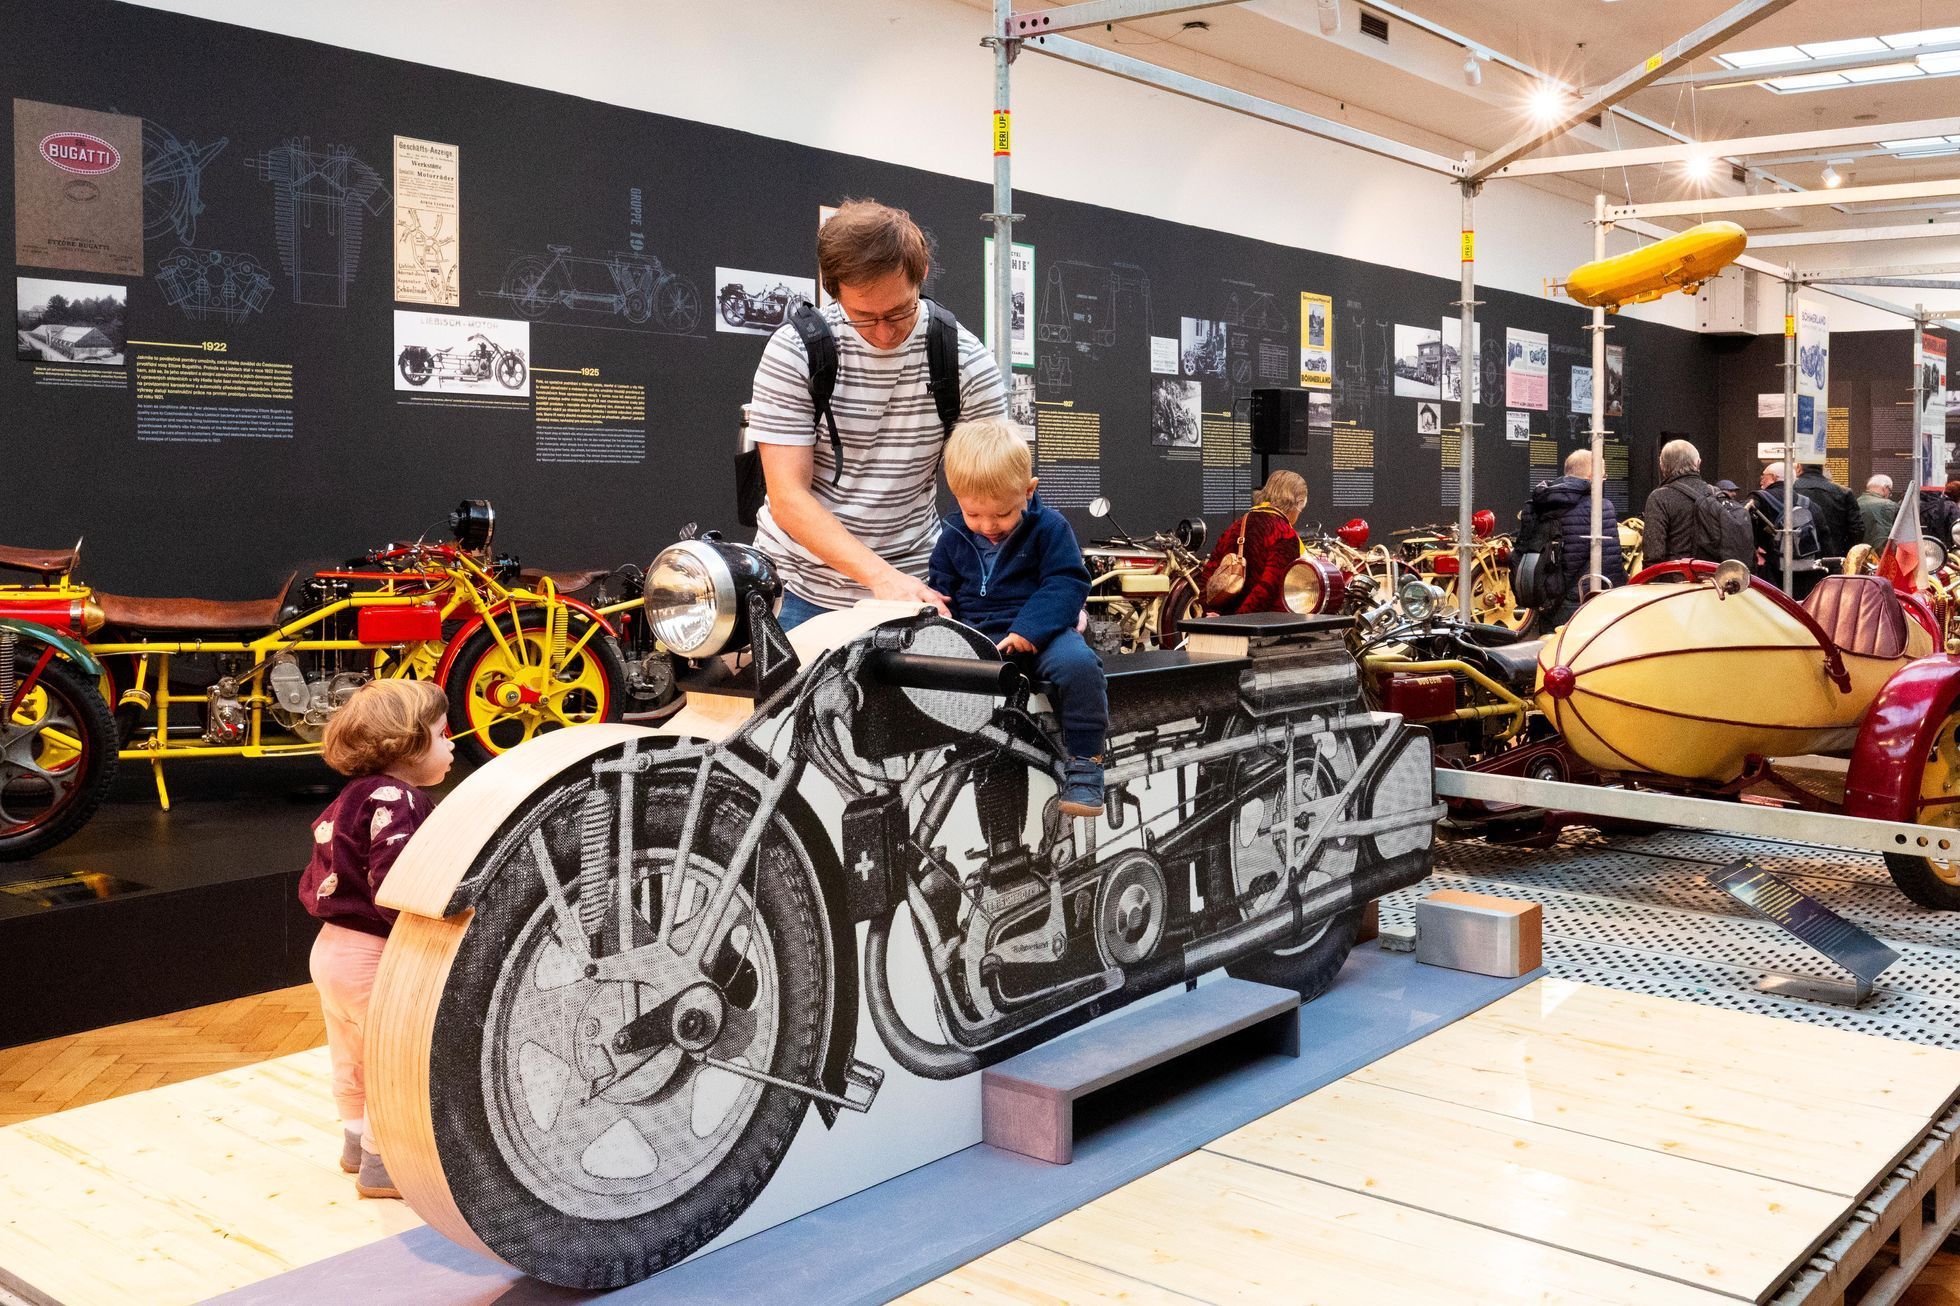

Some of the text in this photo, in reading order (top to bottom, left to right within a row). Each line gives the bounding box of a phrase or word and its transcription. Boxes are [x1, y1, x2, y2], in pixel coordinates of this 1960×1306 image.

[998, 131, 1008, 149] PERI
[49, 143, 110, 165] BUGATTI
[629, 187, 645, 251] GRUPPE 19
[420, 317, 461, 327] LIEBISCH
[201, 341, 227, 352] 1922
[580, 368, 600, 376] 1925
